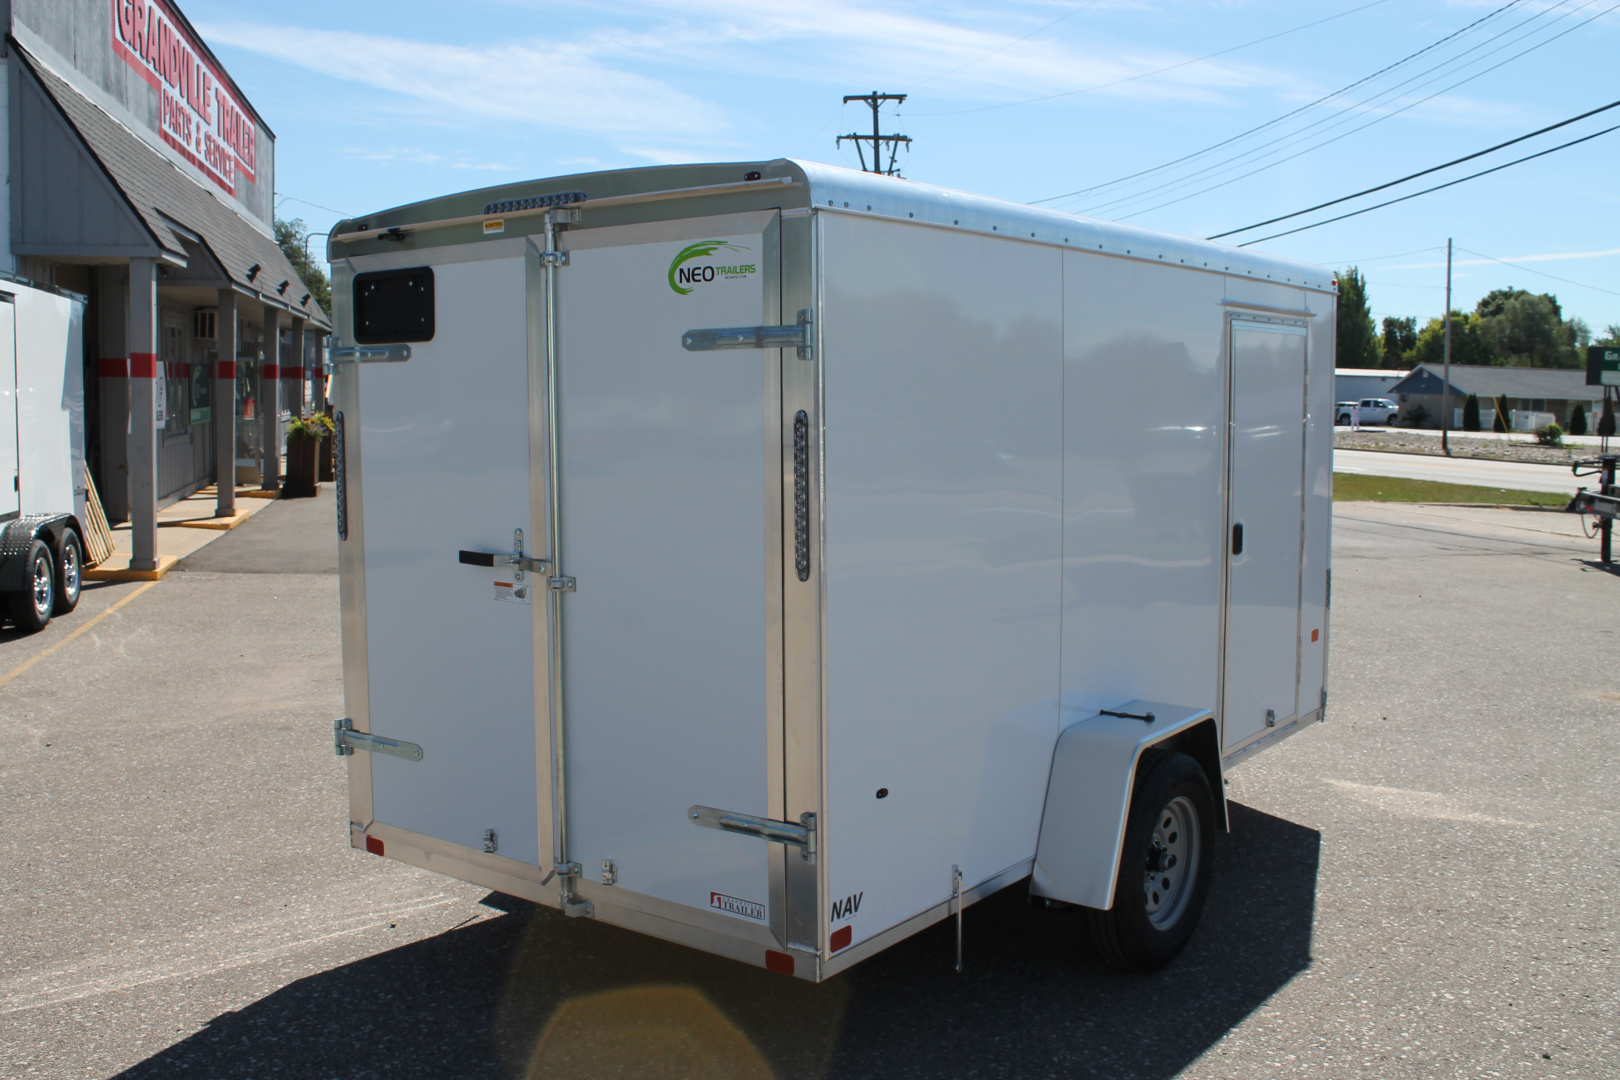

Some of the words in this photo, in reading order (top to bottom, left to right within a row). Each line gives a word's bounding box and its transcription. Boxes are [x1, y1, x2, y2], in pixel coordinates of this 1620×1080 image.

[117, 0, 212, 126] GRANDVILLE
[215, 87, 255, 170] TRAILER
[163, 88, 192, 147] PARTS
[196, 120, 202, 154] &
[204, 130, 235, 184] SERVICE
[679, 265, 714, 284] NEO
[715, 264, 756, 276] TRAILERS
[722, 900, 763, 919] TRAILER
[831, 891, 864, 922] NAV
